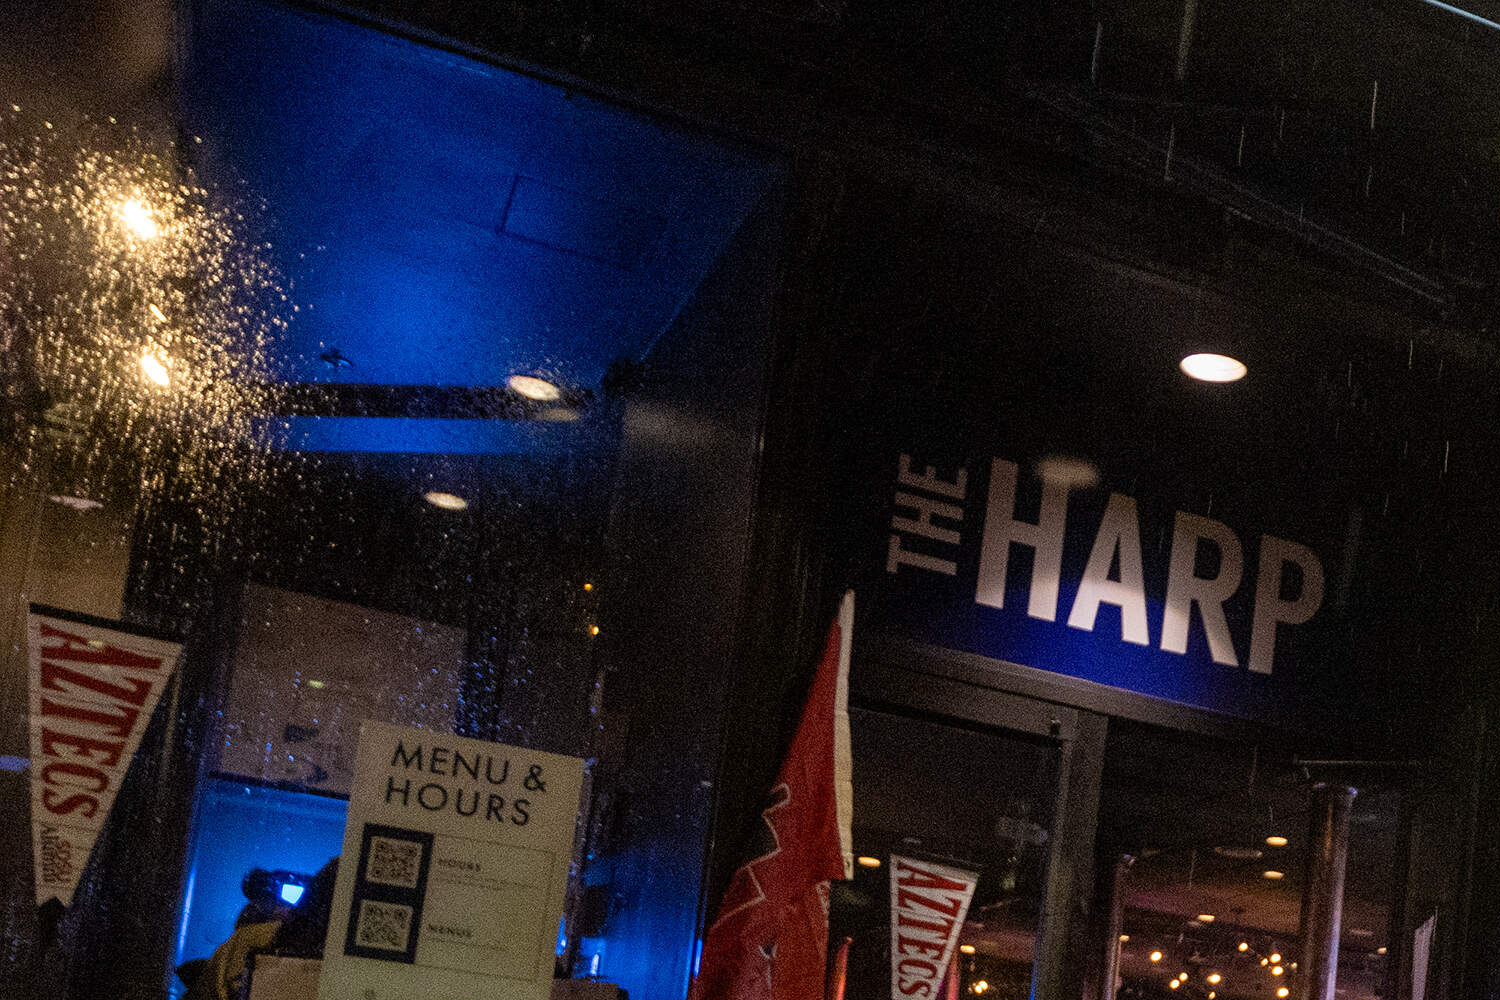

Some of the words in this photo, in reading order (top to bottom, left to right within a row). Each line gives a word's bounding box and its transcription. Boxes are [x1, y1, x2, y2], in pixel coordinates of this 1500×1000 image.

[886, 453, 967, 576] THE
[975, 456, 1325, 675] HARP
[41, 623, 163, 819] AZTECS
[390, 740, 509, 785] MENU
[523, 763, 547, 792] &
[385, 776, 532, 826] HOURS
[898, 862, 967, 998] AZTECS
